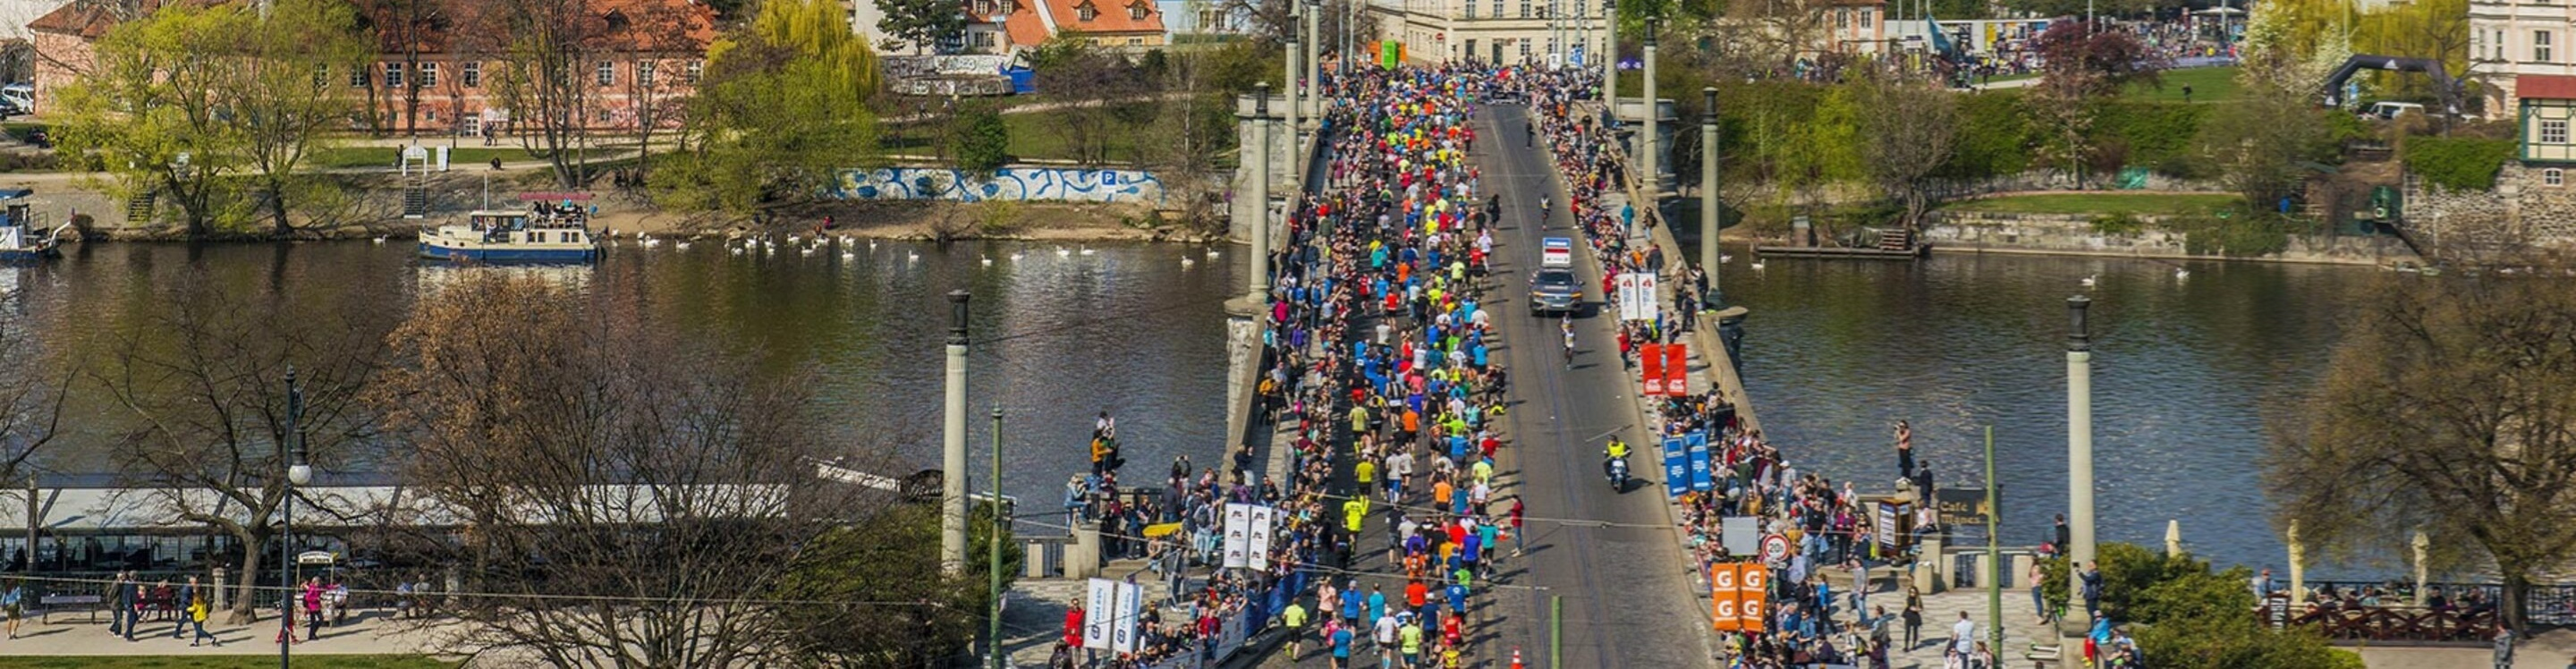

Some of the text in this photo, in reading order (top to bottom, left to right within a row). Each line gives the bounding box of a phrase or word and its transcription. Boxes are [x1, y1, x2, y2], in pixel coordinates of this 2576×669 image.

[1105, 174, 1114, 183] P
[1716, 571, 1732, 588] G
[1745, 571, 1760, 587] G
[1717, 600, 1733, 617] G
[1743, 600, 1758, 616] G
